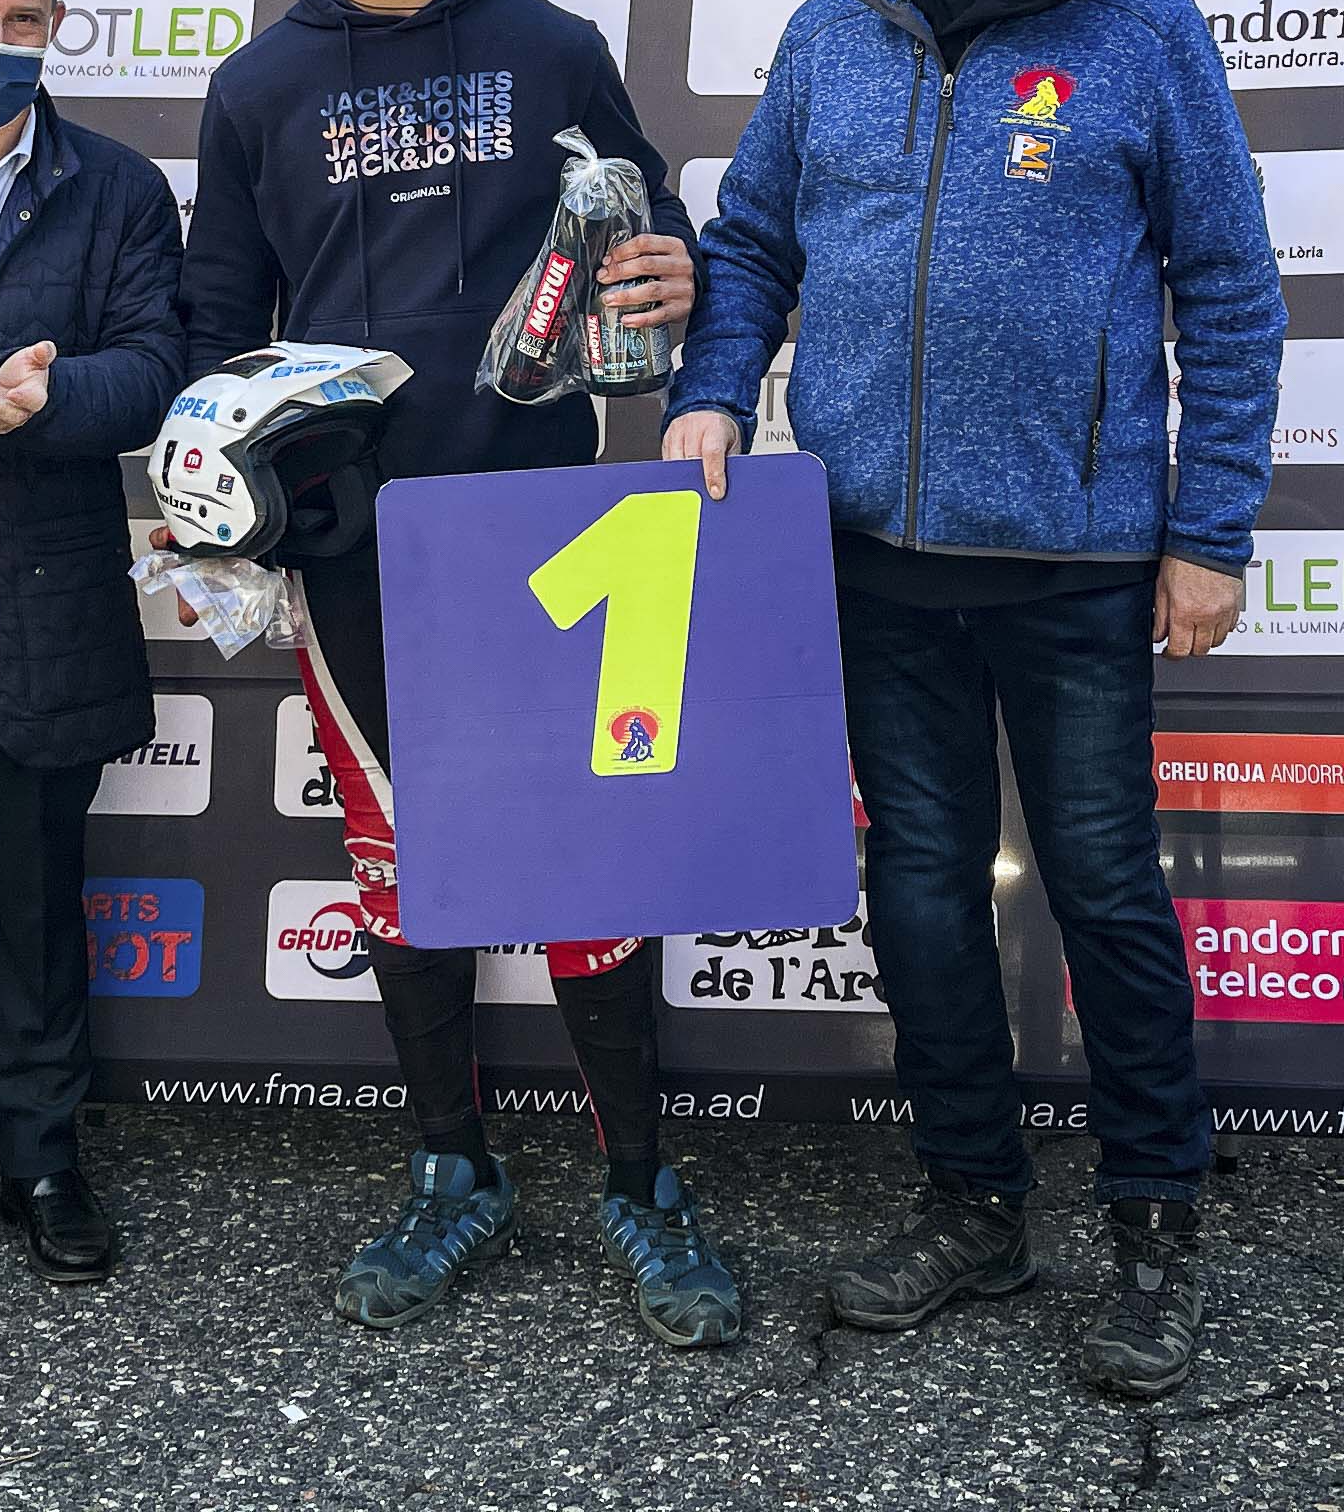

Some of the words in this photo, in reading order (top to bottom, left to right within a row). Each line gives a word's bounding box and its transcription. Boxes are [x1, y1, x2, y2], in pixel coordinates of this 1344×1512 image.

[119, 66, 128, 76] &
[320, 70, 513, 117] JACK&JONES
[322, 93, 513, 140] JACK&JONES
[324, 115, 513, 163] JACK&JONES
[327, 136, 514, 185] JACK&JONES
[390, 185, 451, 204] ORIGINALS
[1289, 245, 1324, 259] Lòria
[530, 259, 570, 334] MOTUL
[588, 316, 602, 361] MOTUL
[293, 363, 341, 374] SPEA
[605, 362, 625, 370] MOTO
[626, 360, 648, 369] WASH
[173, 396, 219, 422] SPEA
[527, 490, 702, 777] 1
[1253, 621, 1264, 634] &
[1158, 760, 1208, 783] CREU
[1211, 761, 1266, 784] ROJA
[690, 955, 753, 1001] de
[143, 1072, 408, 1109] www.fma.ad
